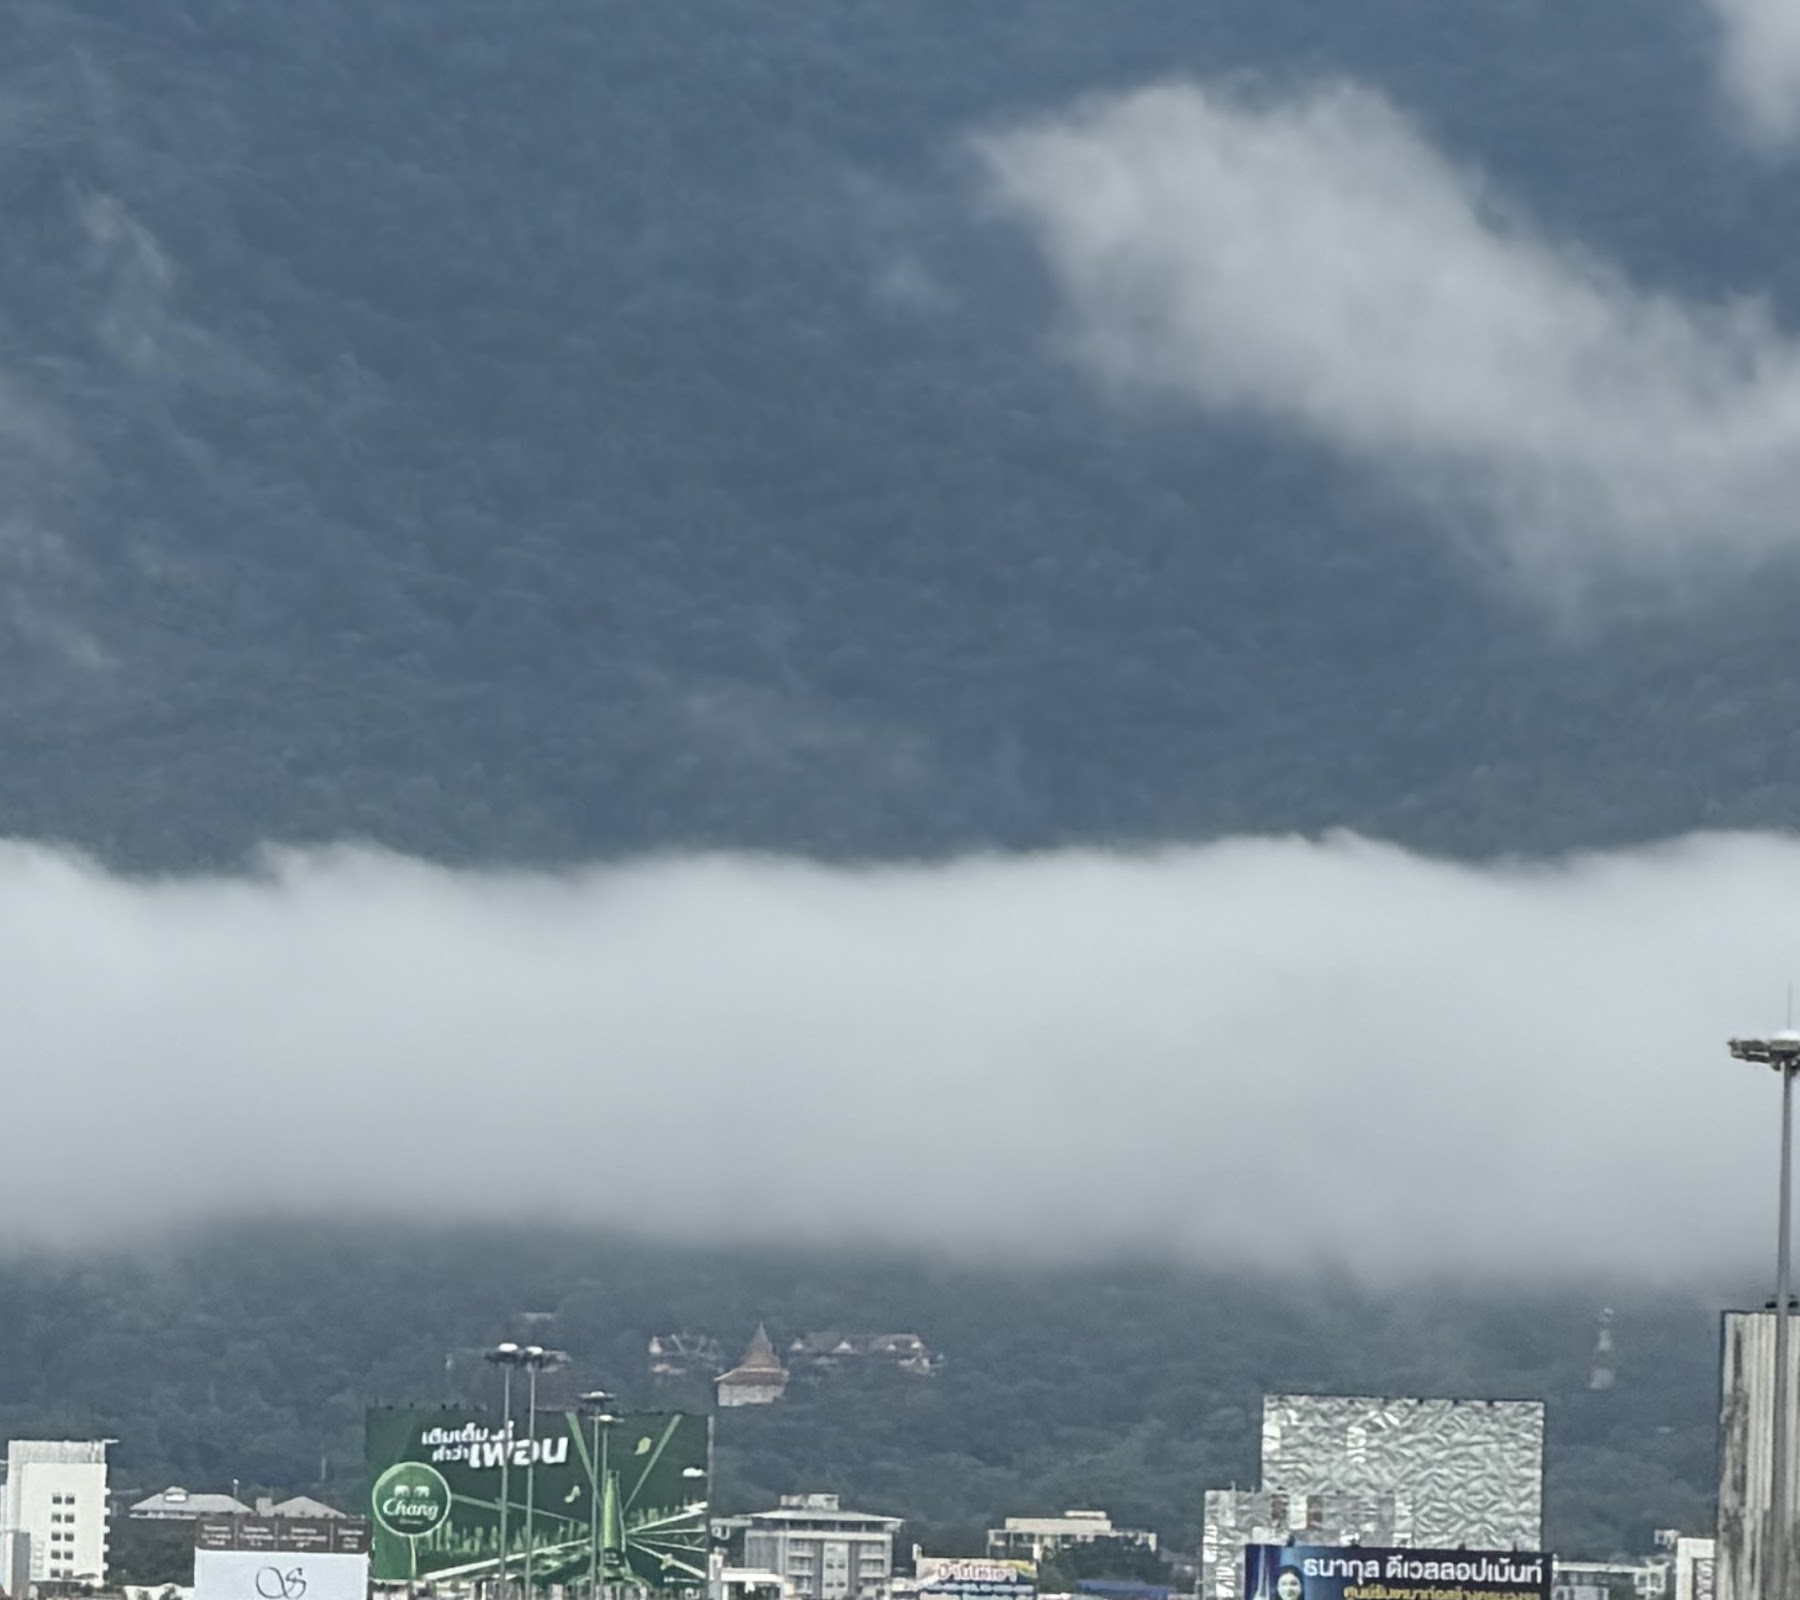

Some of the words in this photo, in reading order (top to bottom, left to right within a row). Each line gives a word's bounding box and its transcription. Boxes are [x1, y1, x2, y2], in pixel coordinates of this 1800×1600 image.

[382, 1498, 439, 1521] Chang
[1303, 1557, 1380, 1586] ธนากุล
